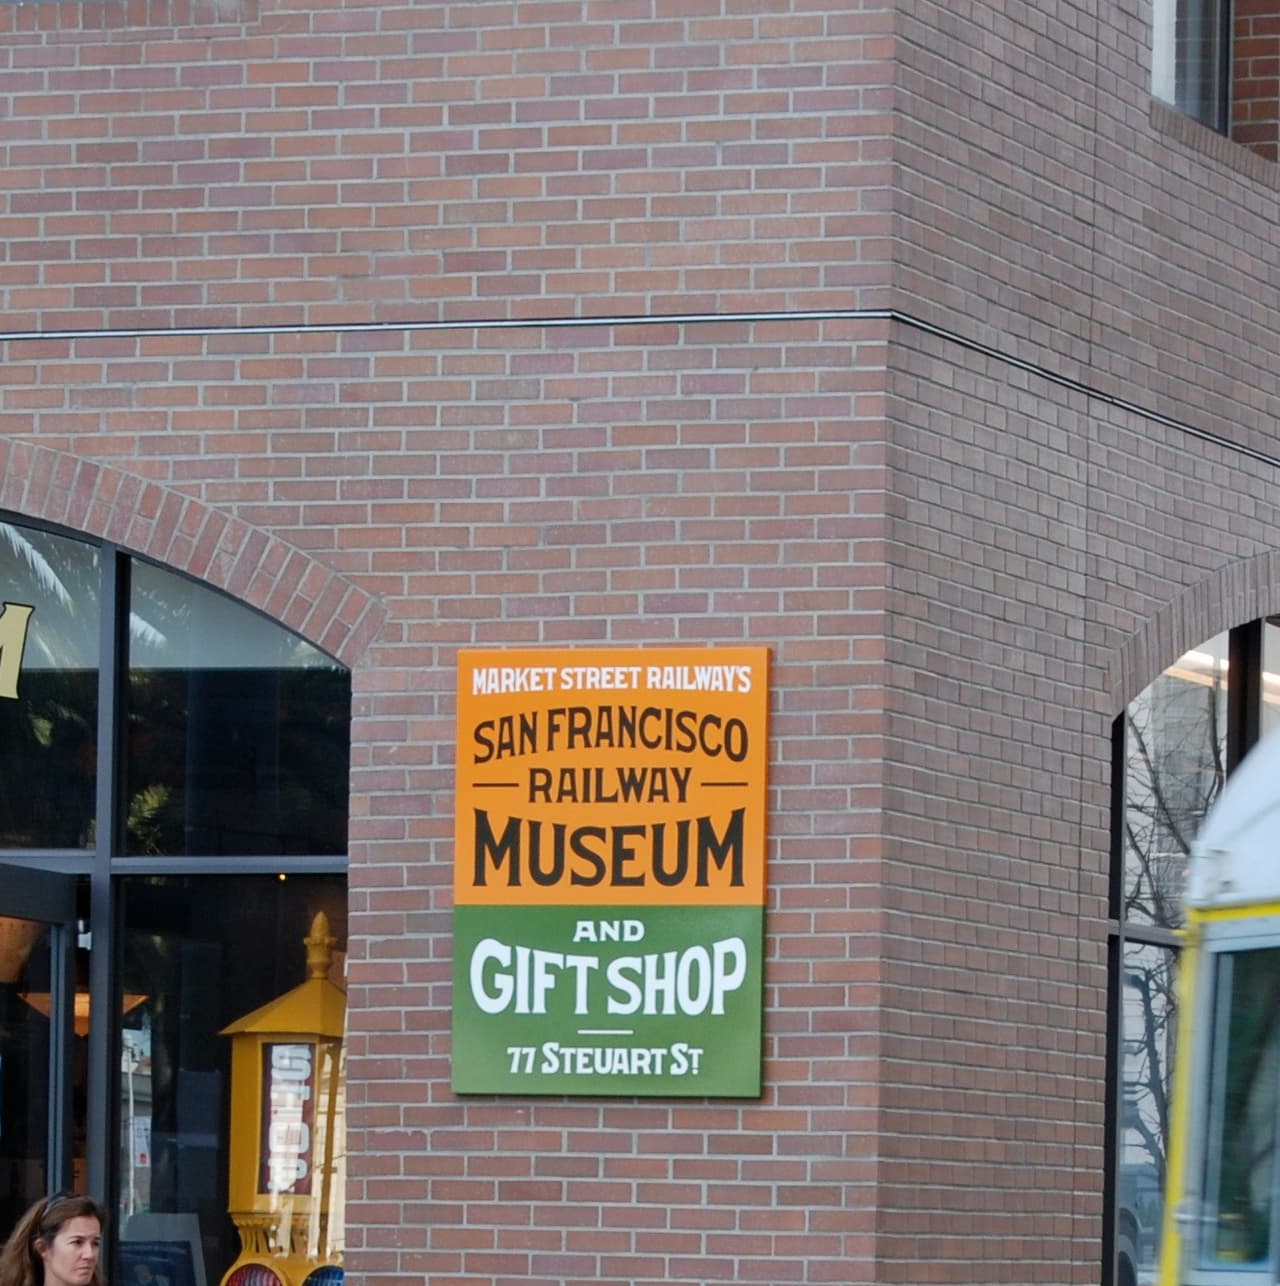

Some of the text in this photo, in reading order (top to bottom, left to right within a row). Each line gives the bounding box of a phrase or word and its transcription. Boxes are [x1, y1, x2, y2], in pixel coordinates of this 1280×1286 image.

[472, 665, 752, 695] MARKET STREET RAILWAY'S
[473, 706, 748, 764] SAN FRANCISCO
[528, 767, 692, 803] RAILWAY
[472, 808, 745, 887] MUSEUM
[573, 919, 645, 942] AND
[470, 936, 747, 1016] GIFT SHOP
[507, 1046, 537, 1074] 77
[542, 1042, 666, 1075] STEUART
